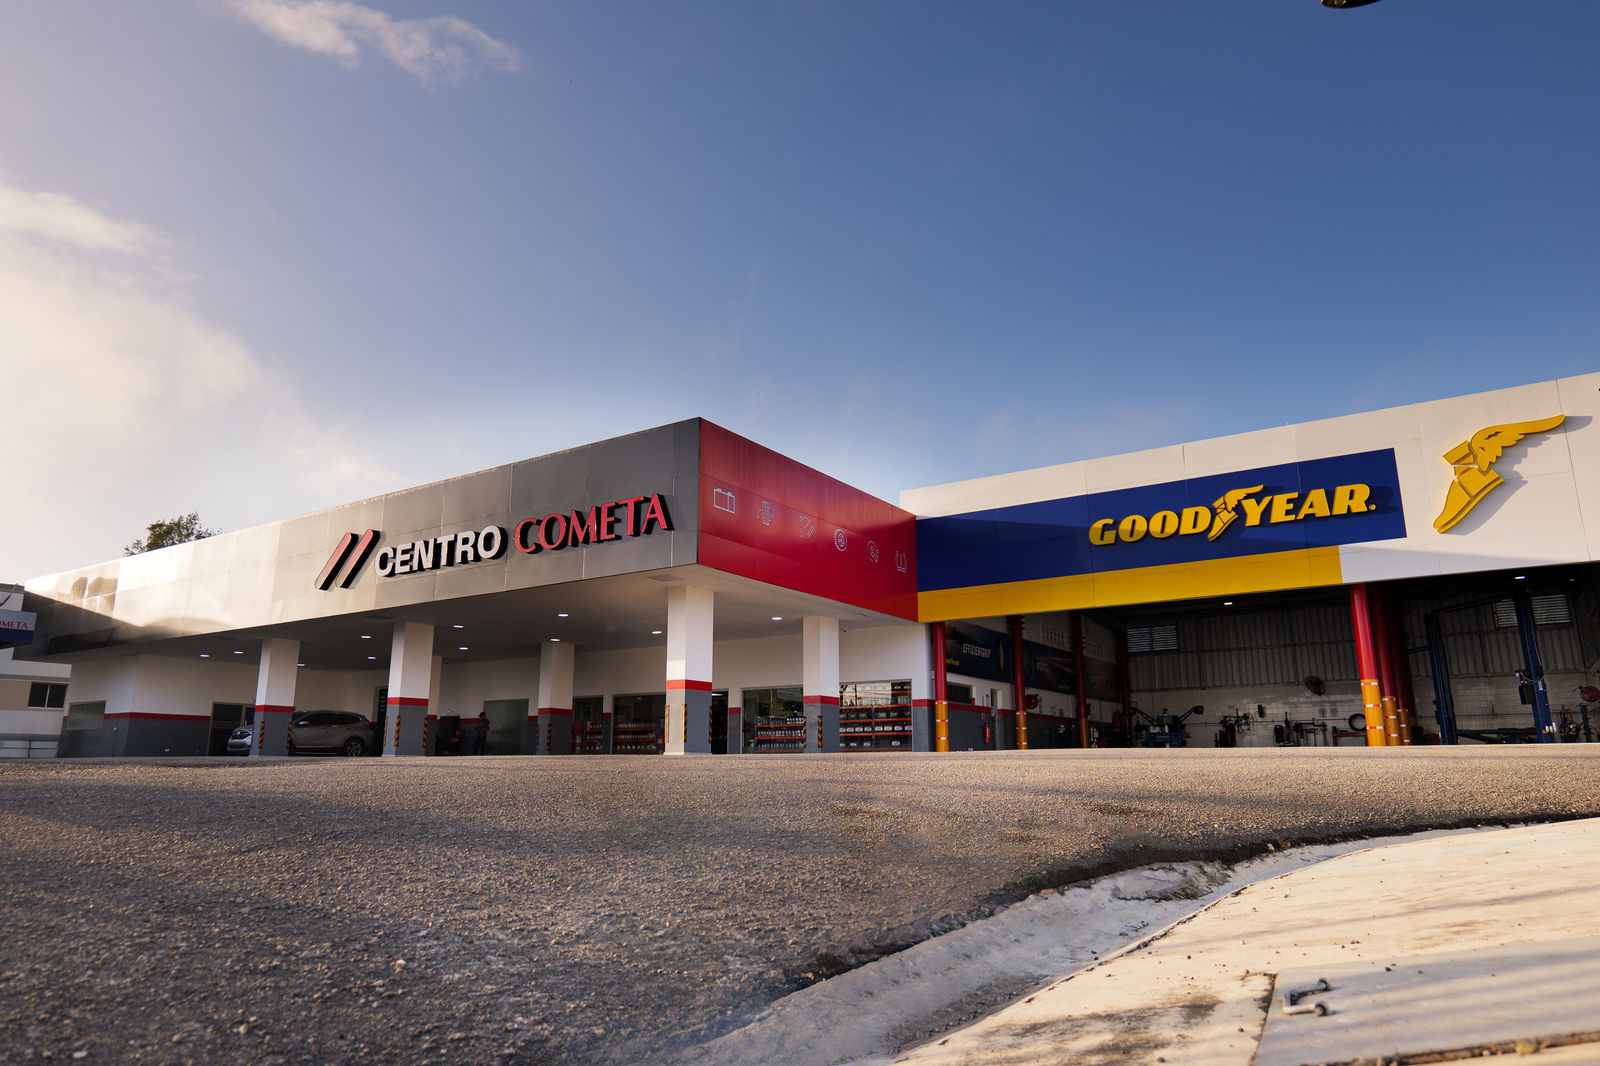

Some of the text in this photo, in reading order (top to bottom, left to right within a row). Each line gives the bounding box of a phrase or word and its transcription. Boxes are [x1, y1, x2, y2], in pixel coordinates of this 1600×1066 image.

[375, 493, 674, 577] CENTRO COMETA
[0, 620, 28, 630] META
